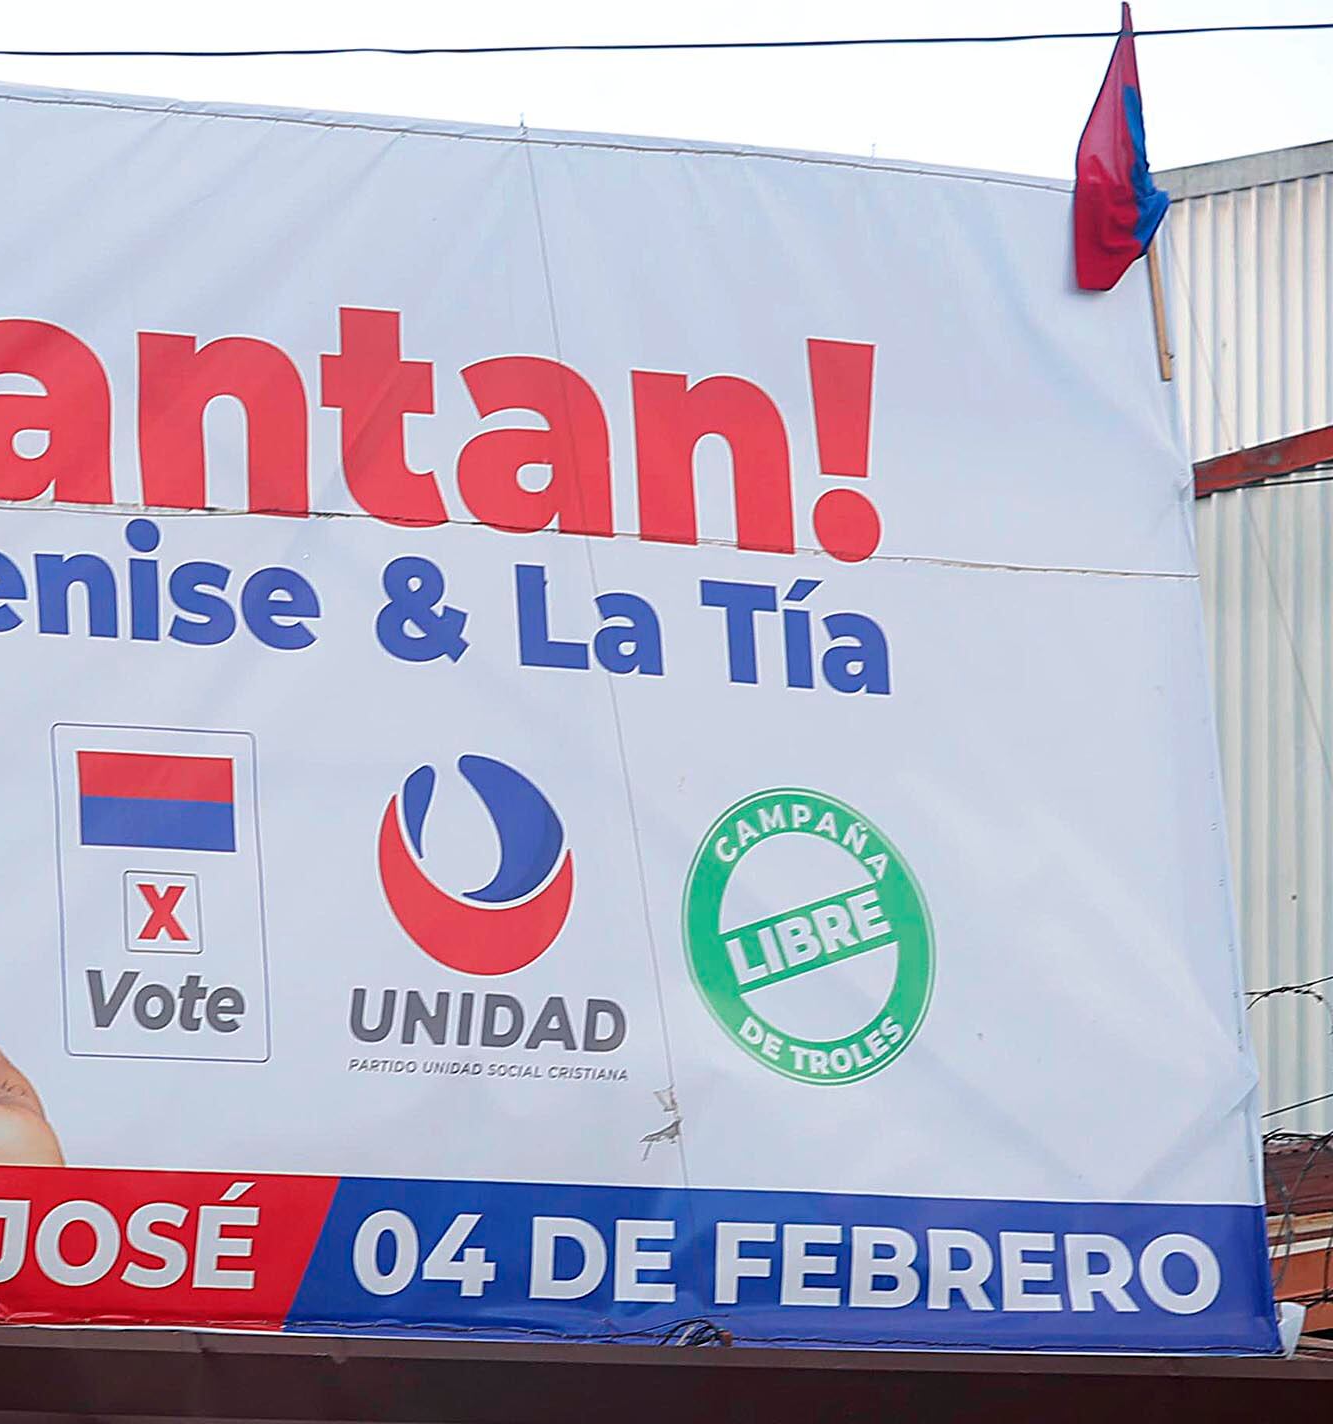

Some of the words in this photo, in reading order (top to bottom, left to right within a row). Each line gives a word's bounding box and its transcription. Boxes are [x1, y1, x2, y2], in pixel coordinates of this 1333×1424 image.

[376, 556, 468, 663] &
[514, 563, 664, 676] La
[699, 579, 892, 695] Tía
[714, 804, 889, 880] CAMPAÑA
[725, 888, 892, 986] LIBRE
[84, 968, 246, 1035] Vote
[349, 987, 628, 1053] UNIDAD
[348, 1058, 417, 1074] PARTIDO
[422, 1060, 483, 1076] UNIDAD
[486, 1063, 543, 1079] SOCIAL
[548, 1066, 630, 1081] CRISTIANA
[738, 1016, 784, 1061] DE
[788, 1016, 904, 1075] TROLES
[352, 1209, 496, 1298] 04
[529, 1214, 677, 1304] DE
[714, 1221, 1221, 1315] FEBRERO
